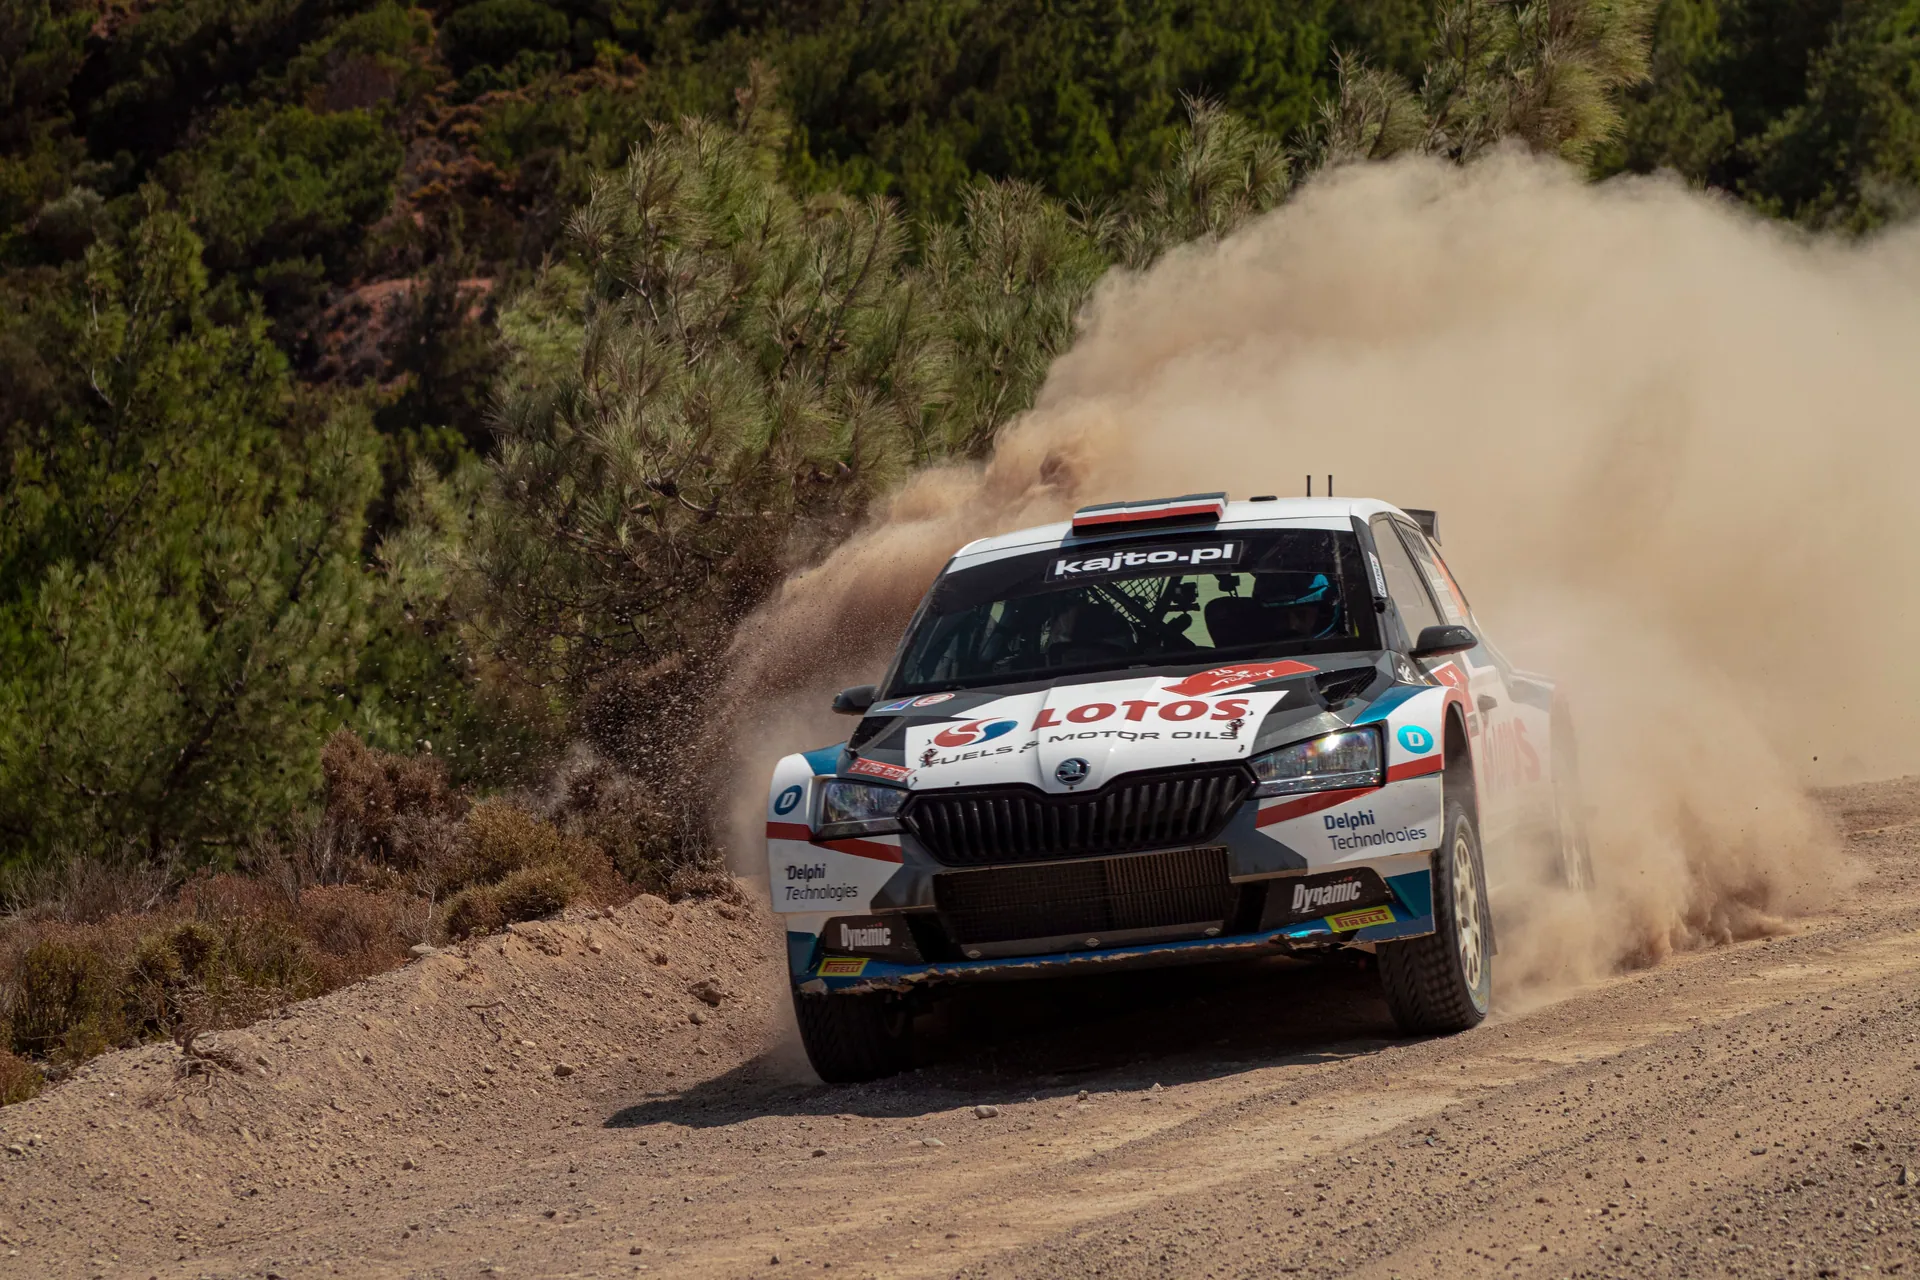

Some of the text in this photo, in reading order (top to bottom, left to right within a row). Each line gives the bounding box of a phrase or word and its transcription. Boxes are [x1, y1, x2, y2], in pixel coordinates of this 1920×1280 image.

[1054, 543, 1234, 575] kajto.pl
[1030, 699, 1249, 731] LOTOS
[1048, 730, 1160, 743] MOTOR
[1171, 731, 1238, 740] OILS
[1323, 809, 1375, 831] Delphi
[787, 863, 826, 882] Delphi
[785, 883, 858, 901] Technologies
[1292, 880, 1362, 914] Dynamic
[1333, 909, 1388, 929] PIRELLI
[840, 923, 891, 951] Dynamic
[822, 961, 863, 973] PIRELLI
